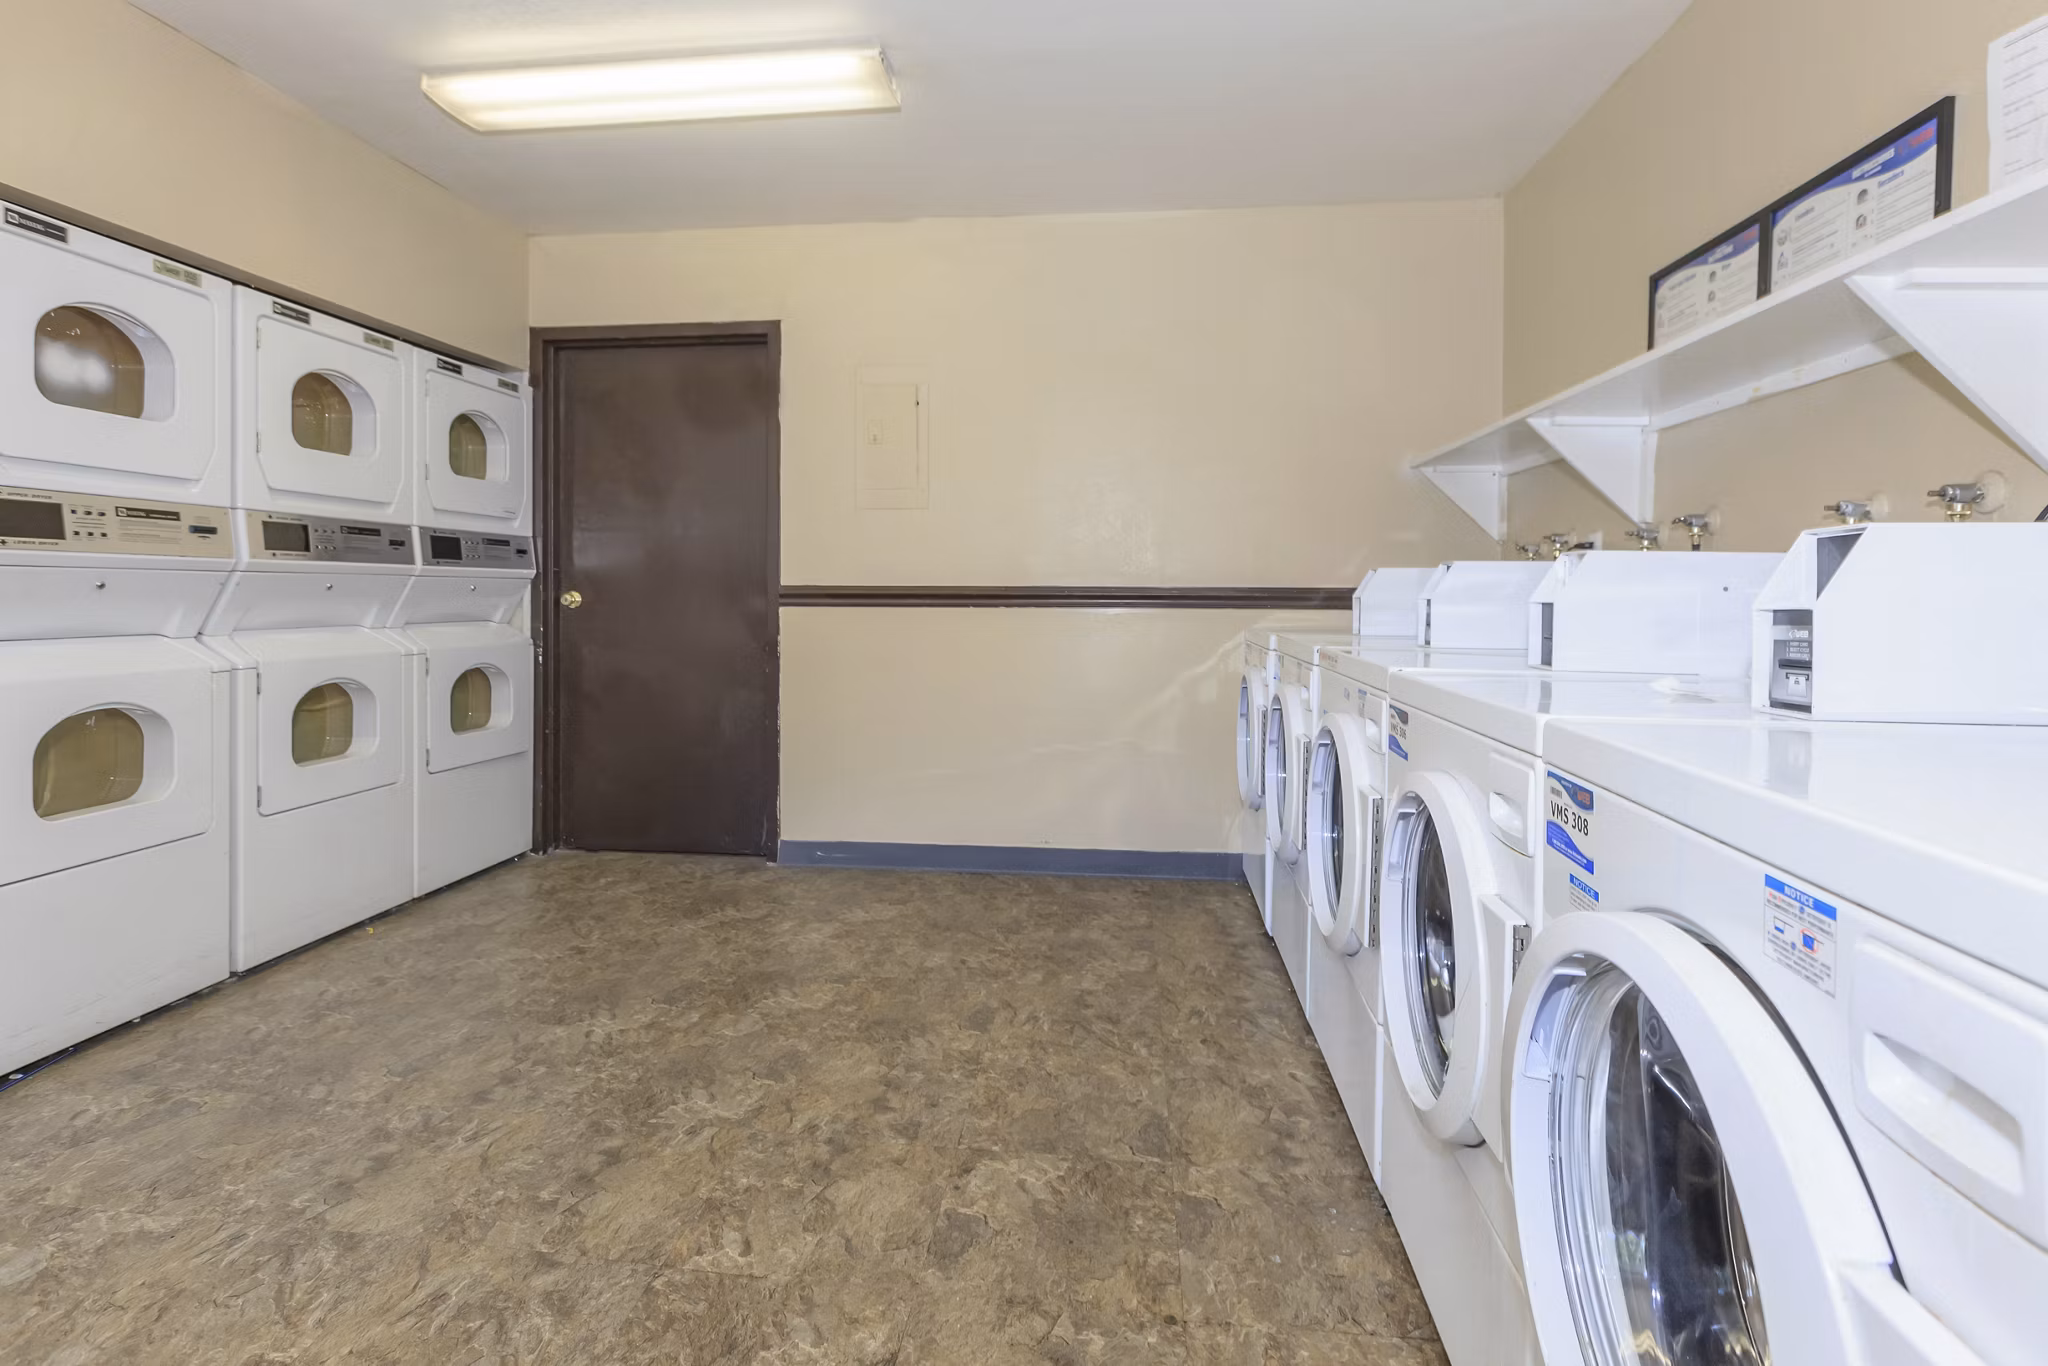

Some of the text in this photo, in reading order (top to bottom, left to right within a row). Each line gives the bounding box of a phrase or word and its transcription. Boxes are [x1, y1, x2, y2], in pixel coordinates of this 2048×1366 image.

[1550, 800, 1569, 825] VMS
[1571, 811, 1589, 837] 308
[1573, 877, 1596, 899] NOTICE
[1784, 885, 1815, 908] NOTICE
